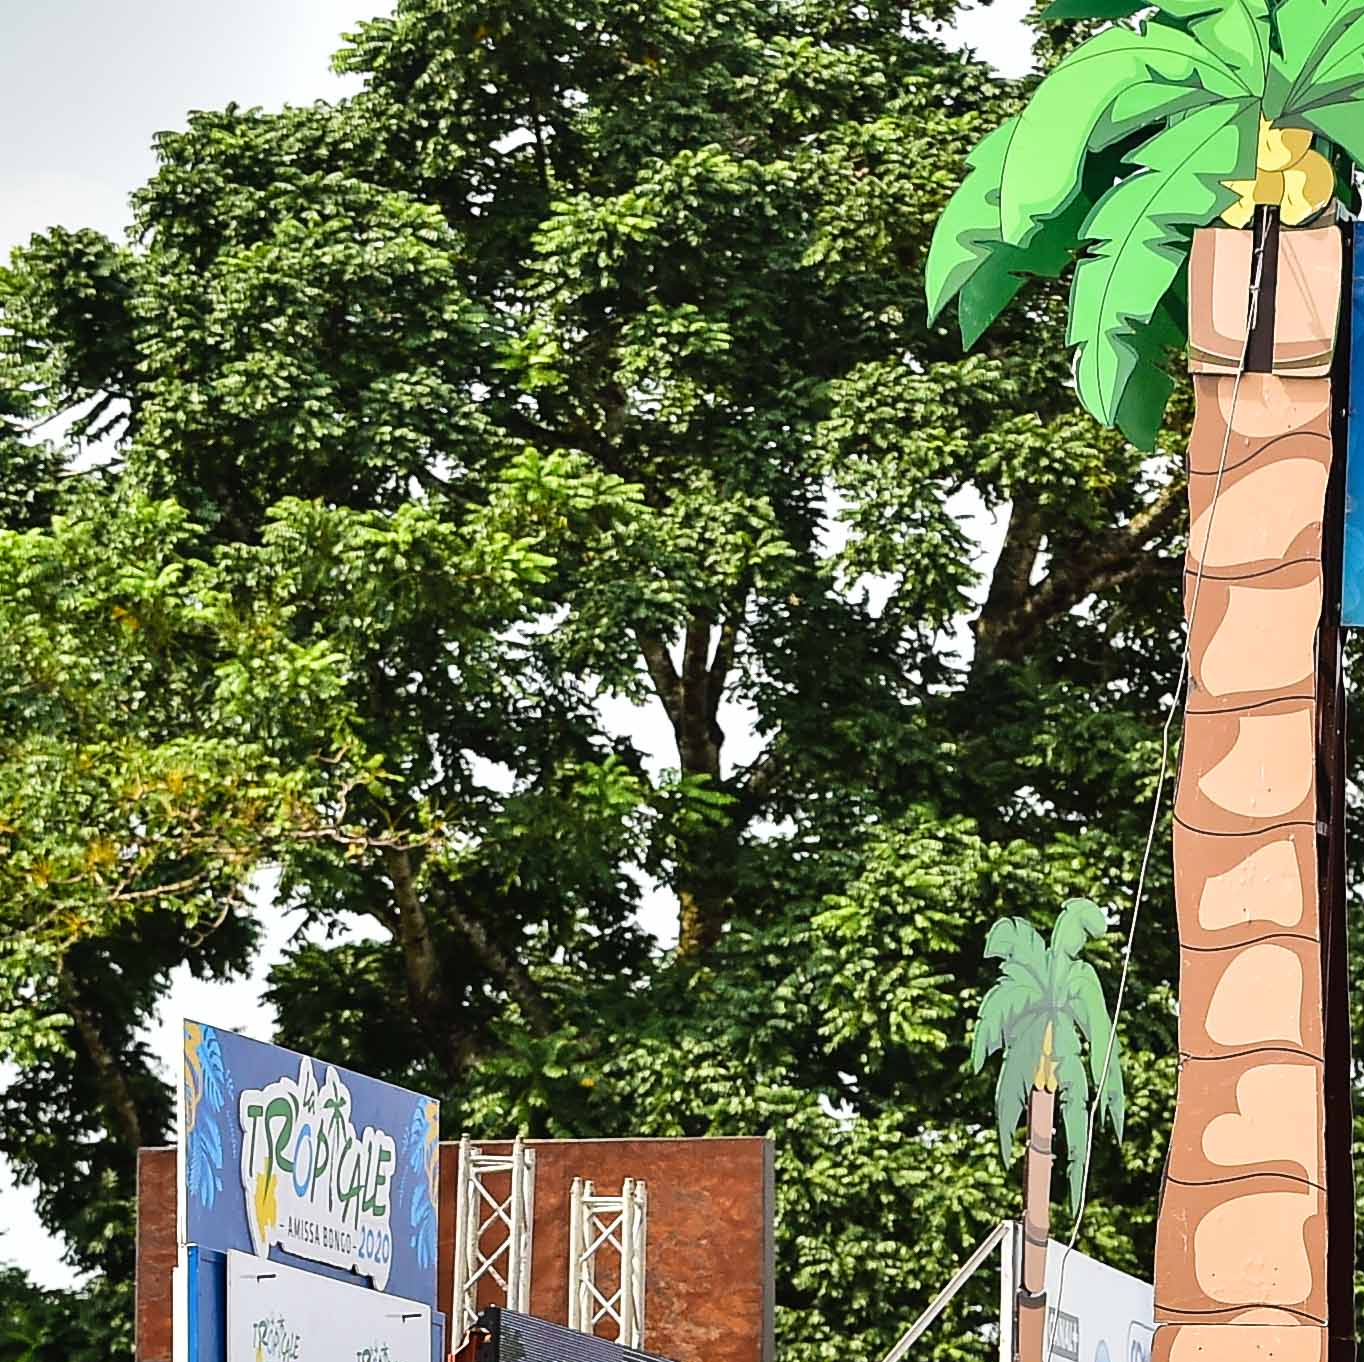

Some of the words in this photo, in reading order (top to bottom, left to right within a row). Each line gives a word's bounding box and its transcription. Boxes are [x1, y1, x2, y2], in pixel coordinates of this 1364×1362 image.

[247, 1091, 392, 1230] TROPICALE
[288, 1215, 321, 1246] AMISSA
[322, 1225, 352, 1255] BONGO
[358, 1223, 391, 1264] 2020
